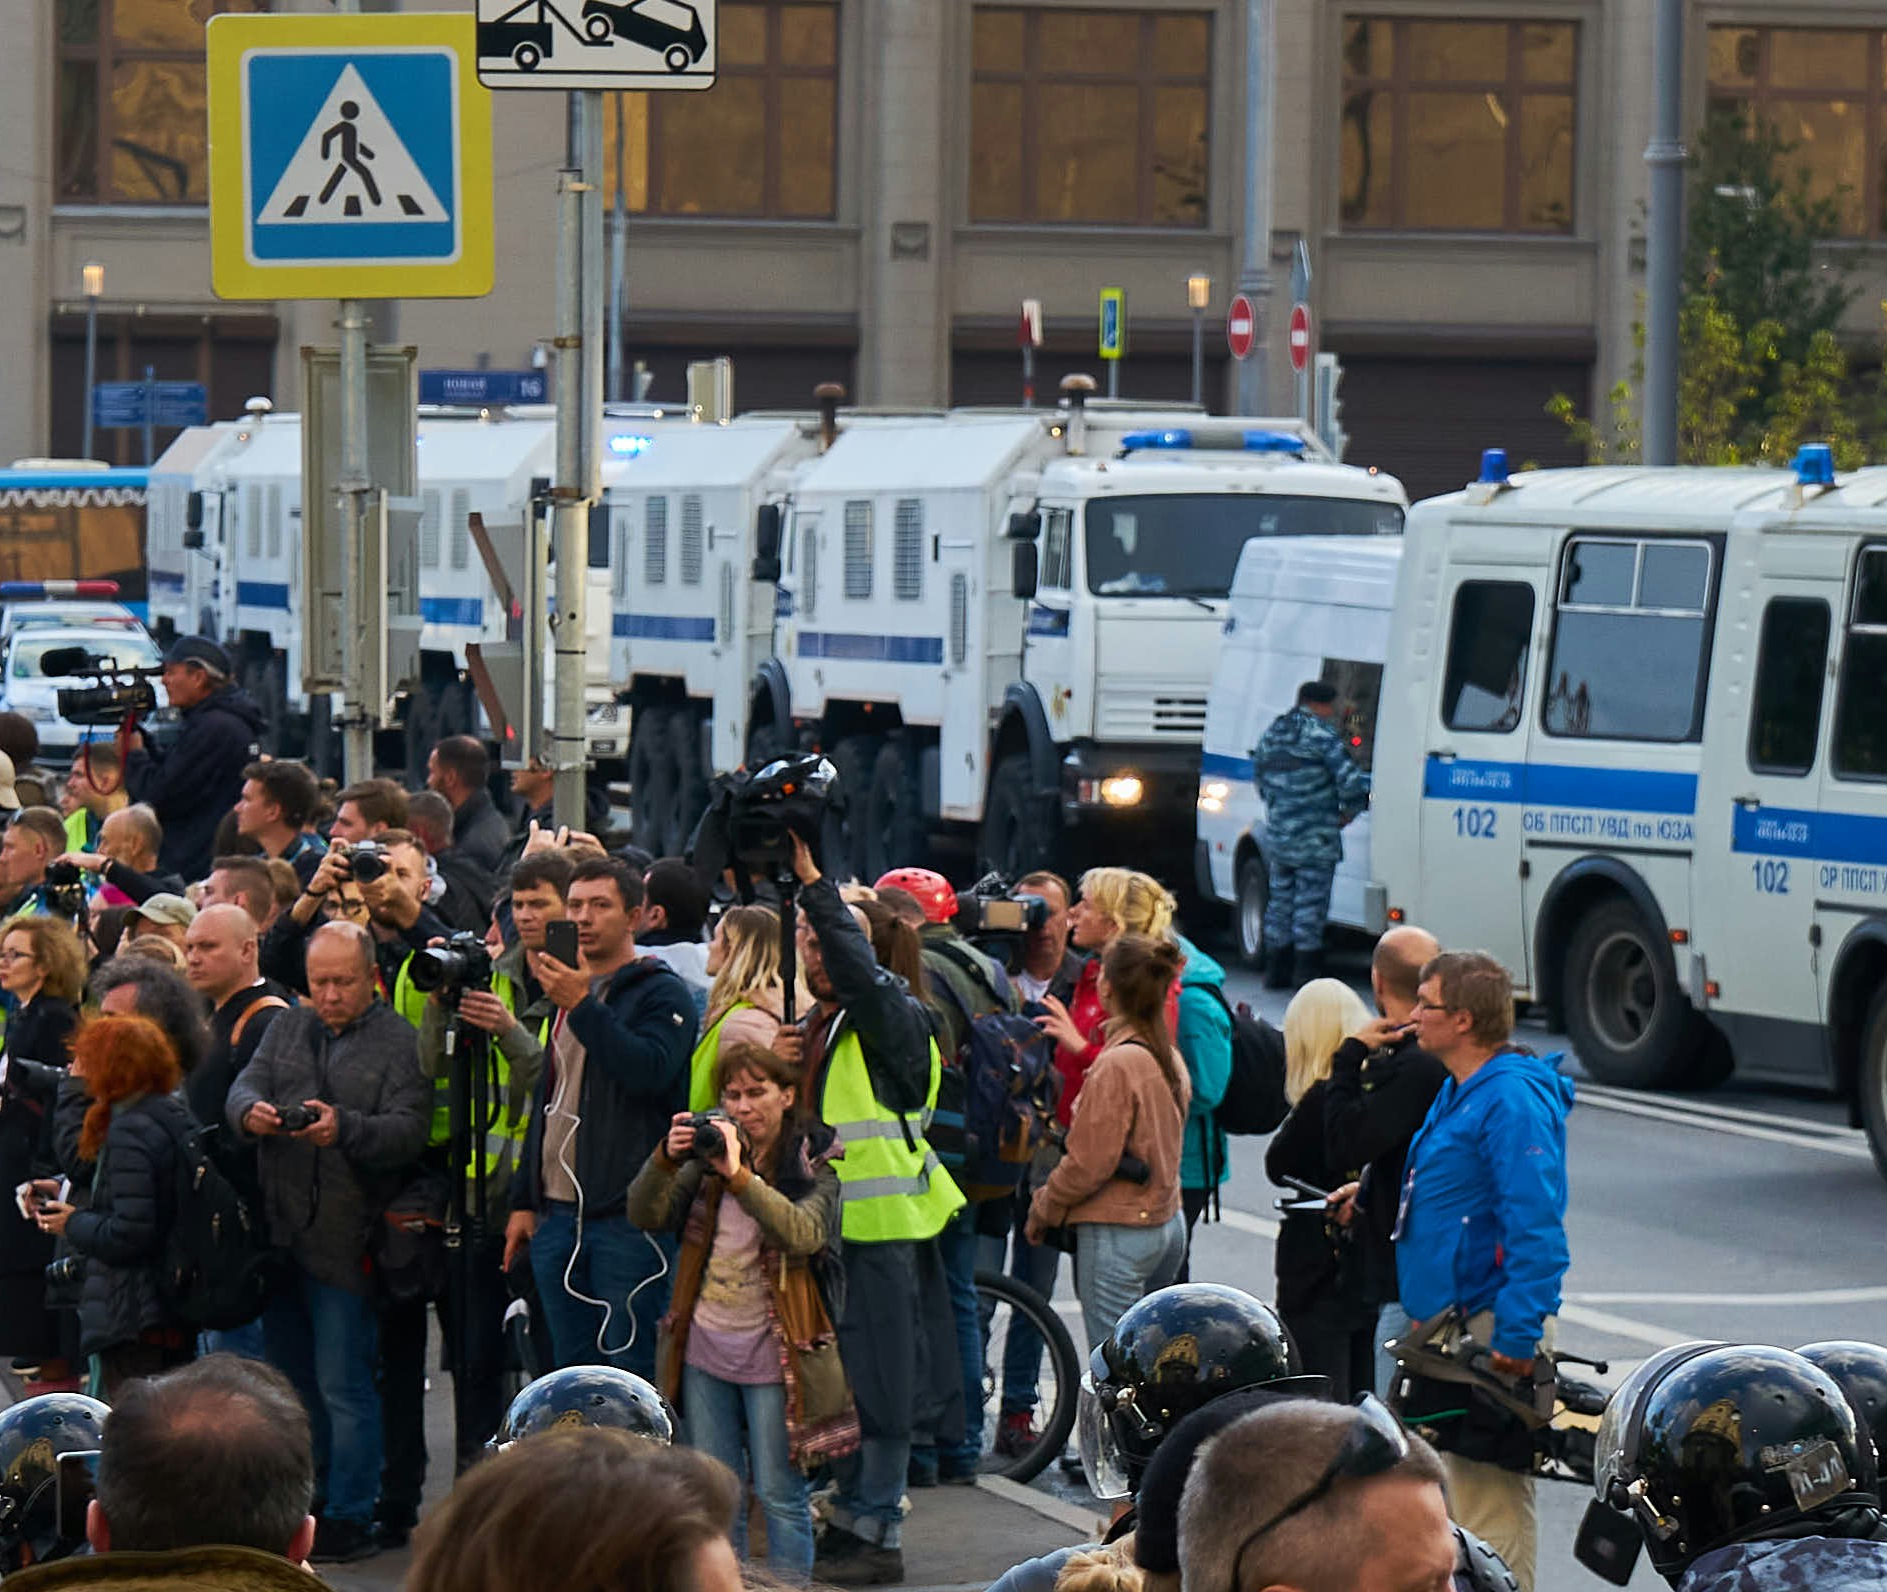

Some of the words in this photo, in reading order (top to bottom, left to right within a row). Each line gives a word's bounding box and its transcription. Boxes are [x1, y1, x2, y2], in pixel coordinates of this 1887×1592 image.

[1452, 806, 1497, 839] 102
[1550, 812, 1594, 835] ППСП
[1597, 814, 1629, 839] УВД
[1633, 823, 1652, 838] по
[1752, 859, 1790, 894] 102
[1841, 865, 1877, 891] ППСП
